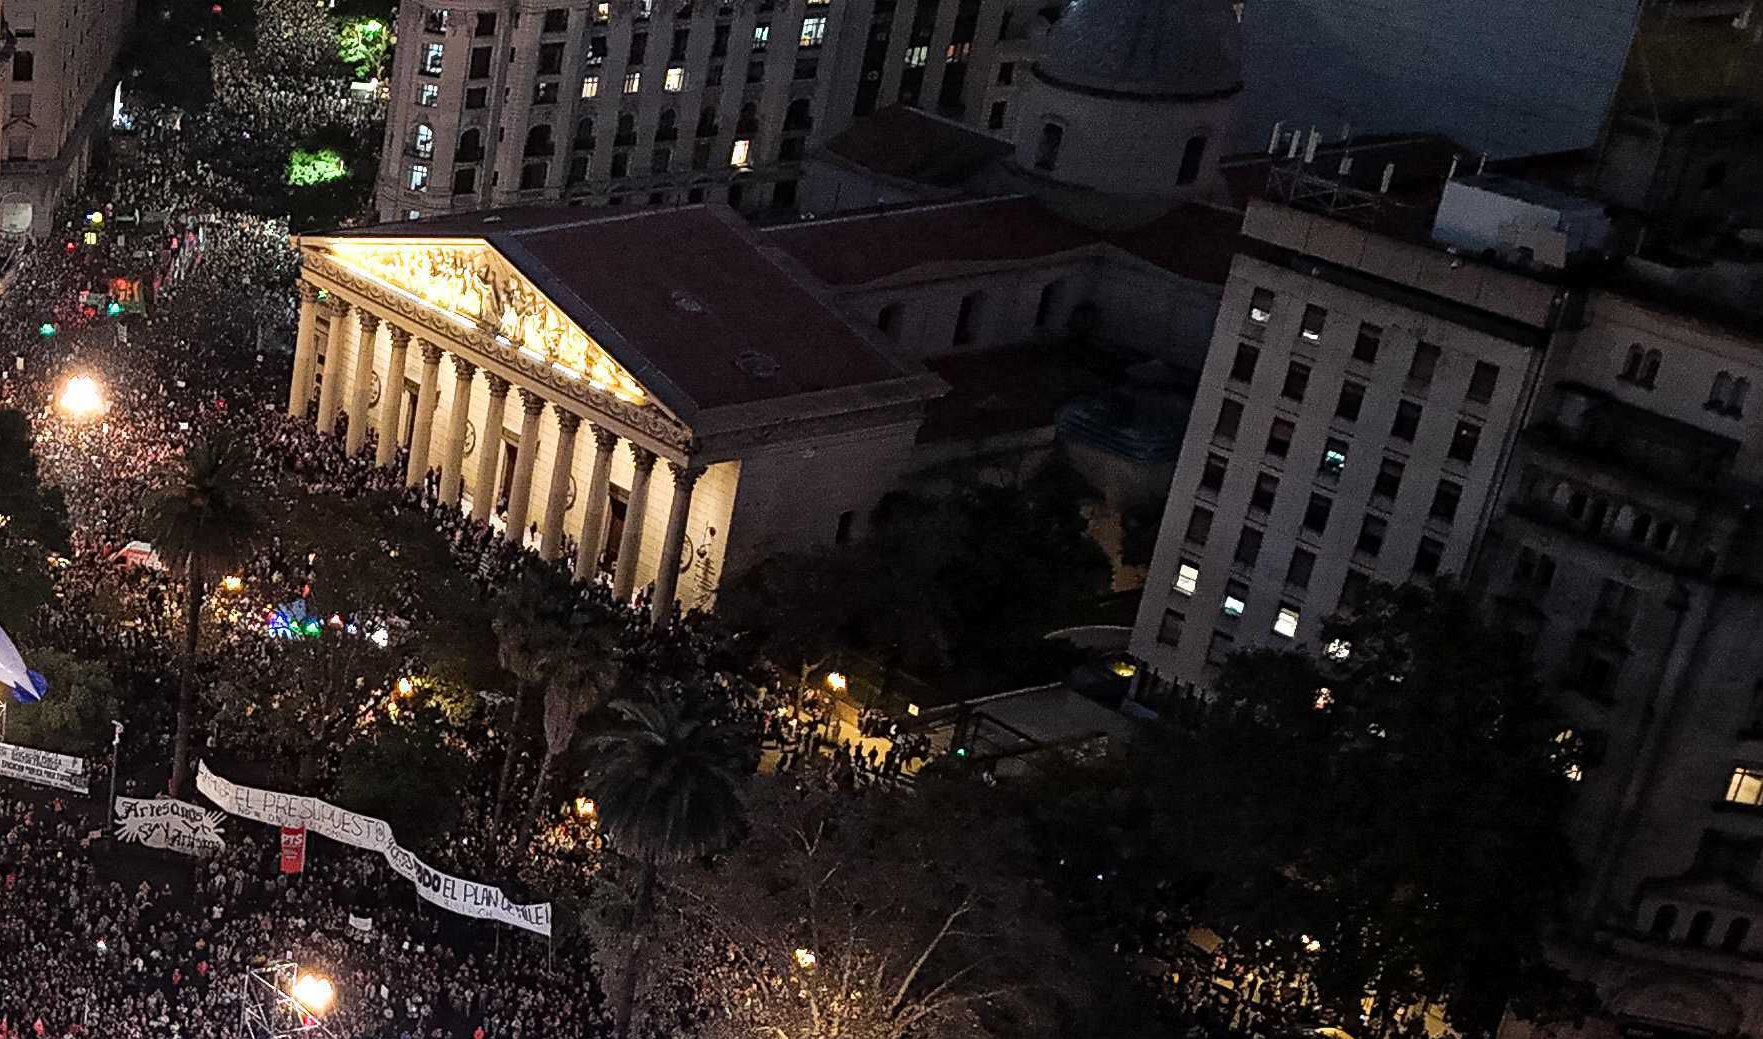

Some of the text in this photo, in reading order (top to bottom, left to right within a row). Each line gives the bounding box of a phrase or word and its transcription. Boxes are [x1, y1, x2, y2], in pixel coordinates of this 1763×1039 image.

[121, 800, 205, 822] Artesanos
[235, 788, 253, 809] EL
[263, 793, 386, 842] PRESUPUESTO
[442, 879, 457, 900] EL
[464, 883, 499, 907] PLAN
